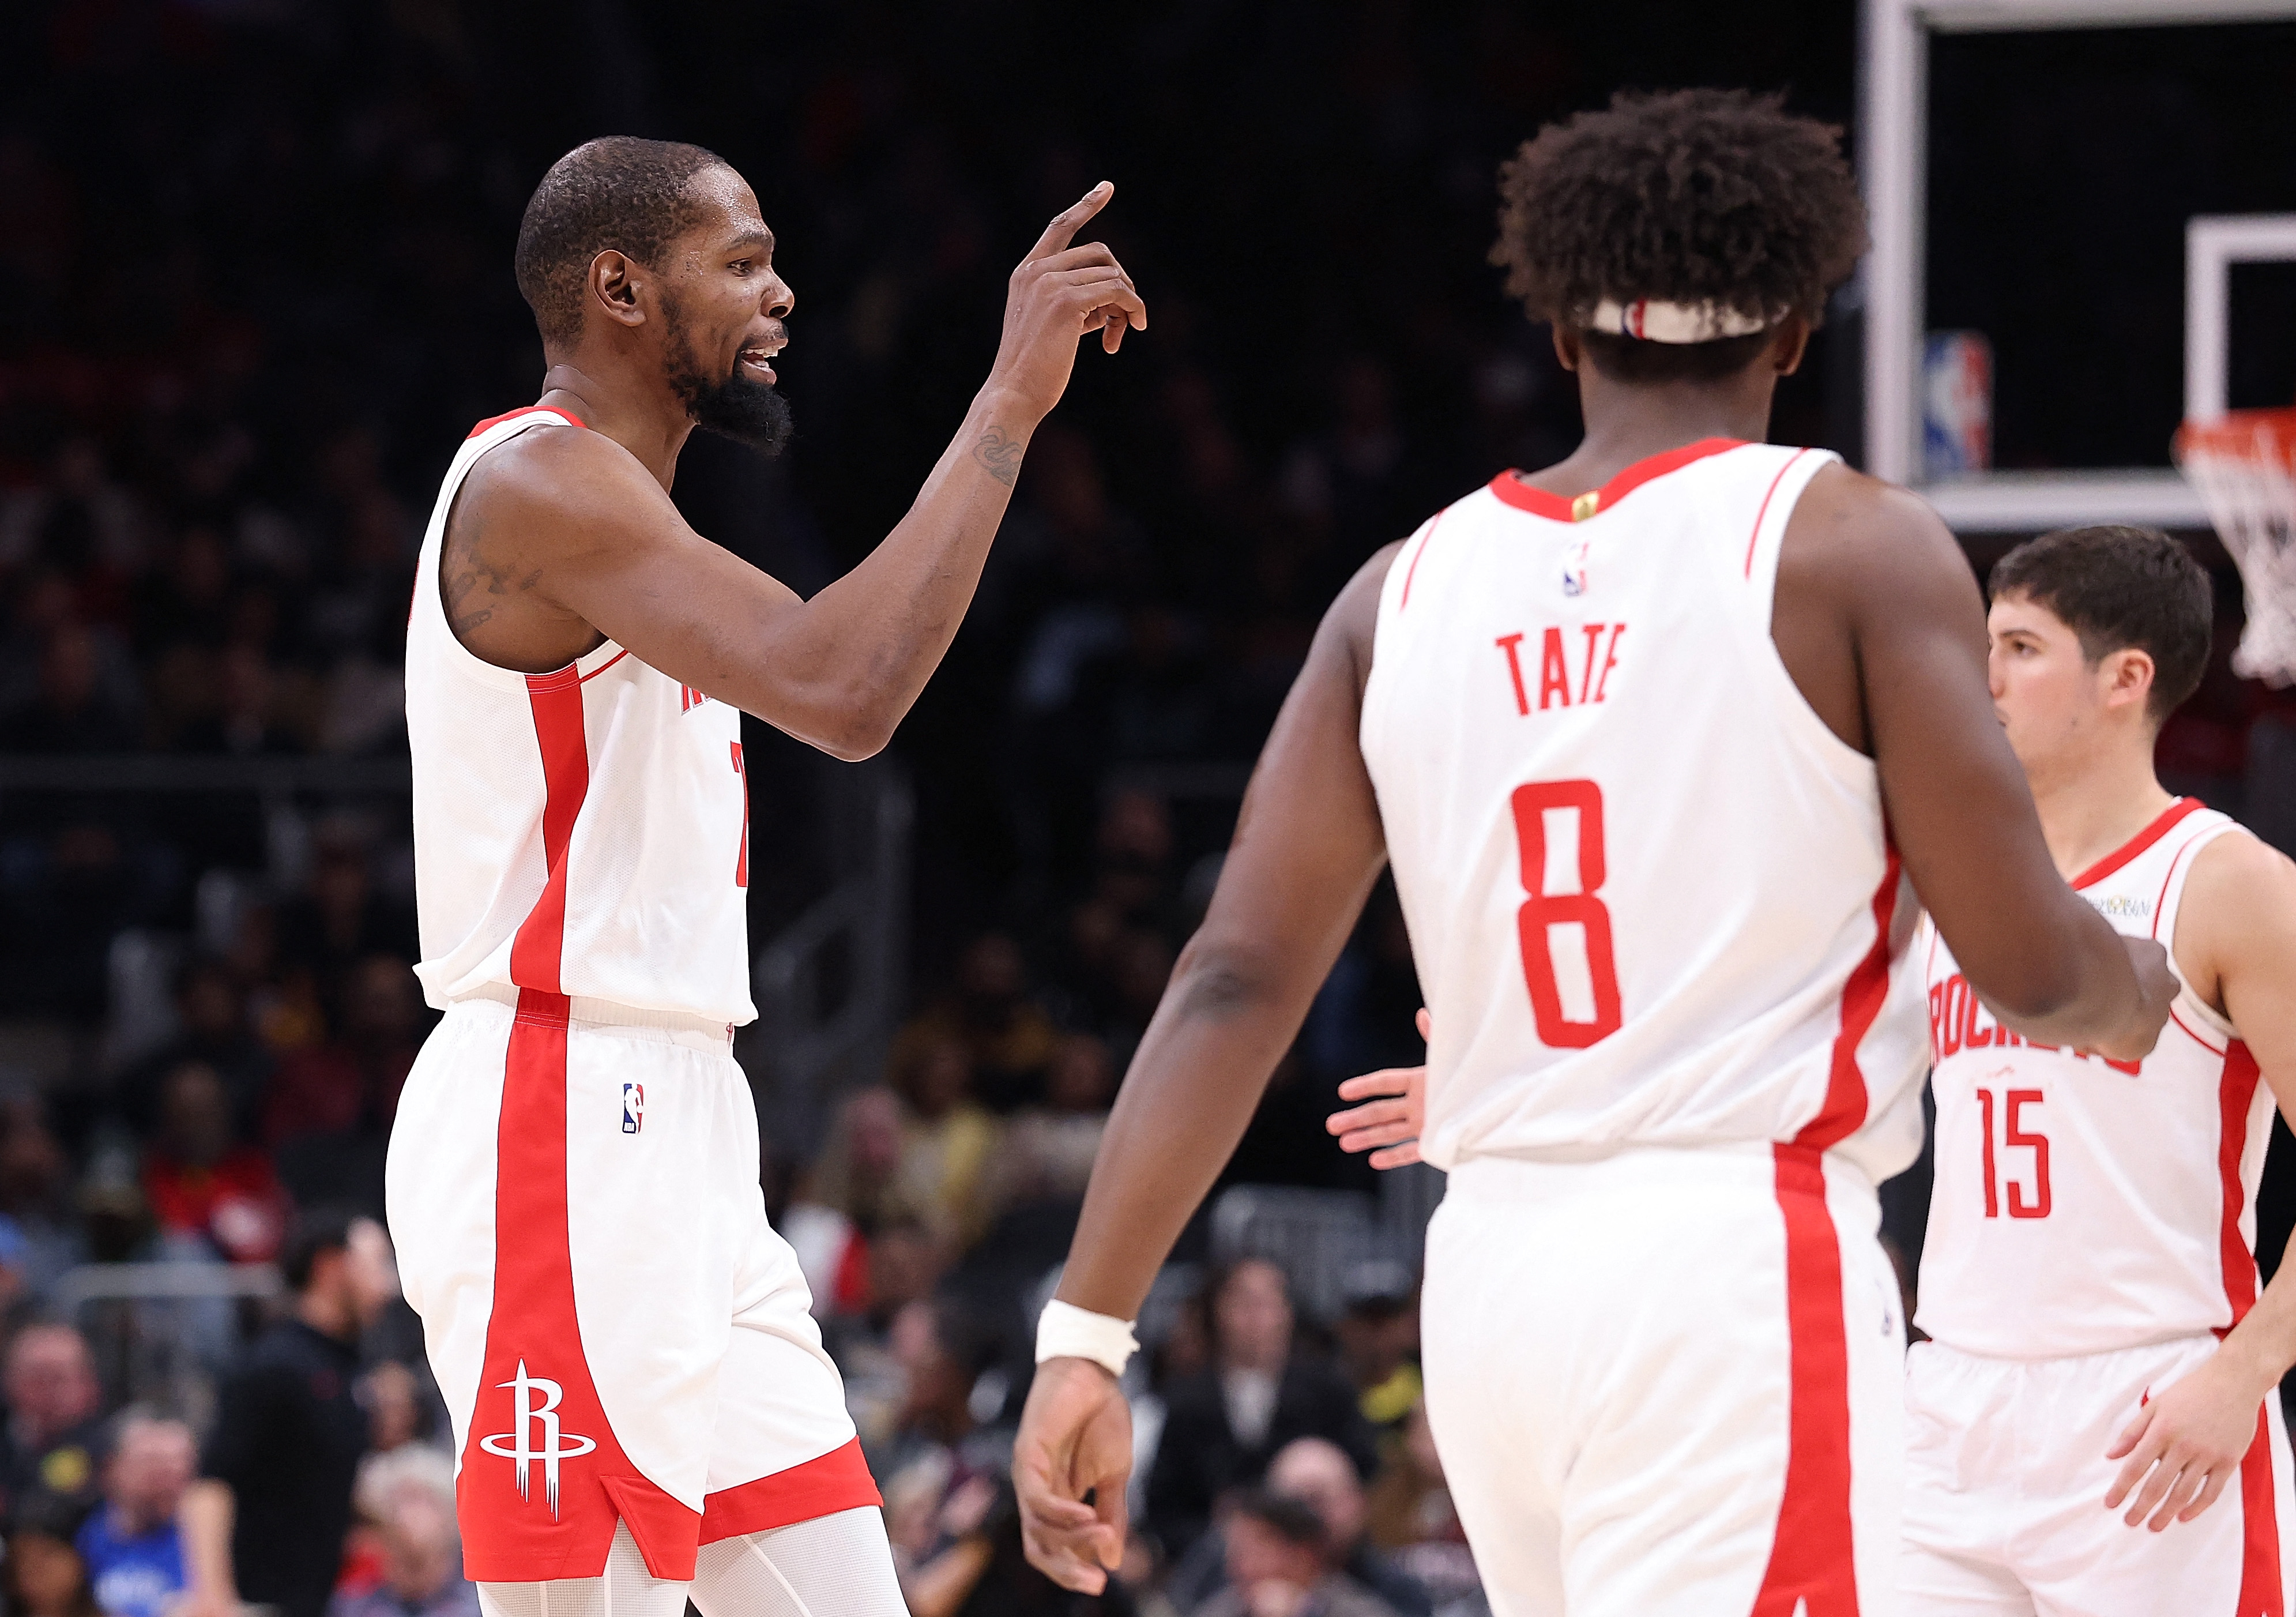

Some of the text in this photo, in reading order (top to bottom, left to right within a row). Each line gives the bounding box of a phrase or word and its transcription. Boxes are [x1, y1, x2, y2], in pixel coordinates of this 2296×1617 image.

[1495, 623, 1626, 716] TATE
[1510, 779, 1623, 1050] 8
[1976, 1088, 2052, 1219] 15
